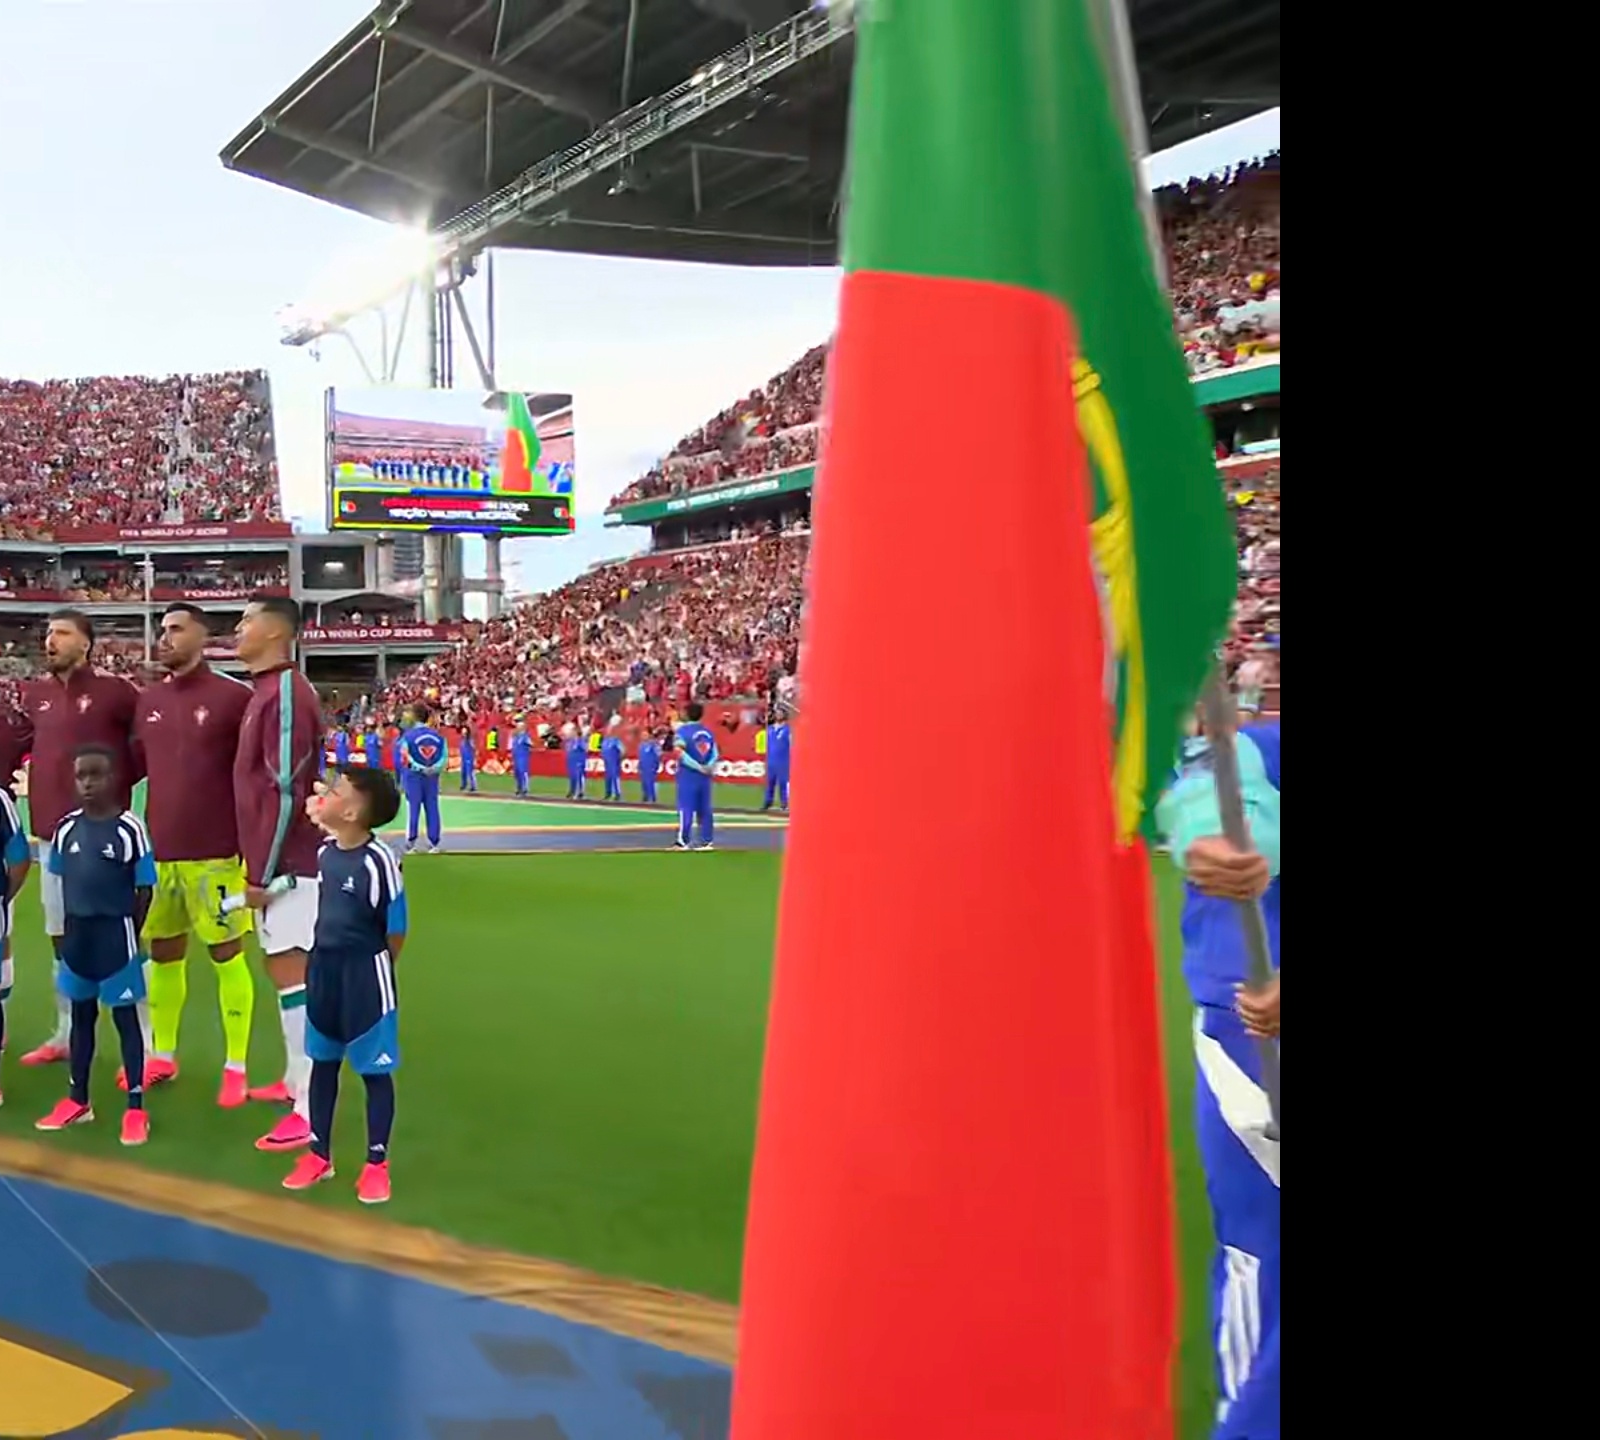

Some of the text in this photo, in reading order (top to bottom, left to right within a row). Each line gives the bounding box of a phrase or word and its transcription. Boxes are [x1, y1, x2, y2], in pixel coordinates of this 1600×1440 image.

[303, 630, 327, 639] FIFA
[328, 629, 368, 638] WORLD
[369, 628, 393, 637] CUP
